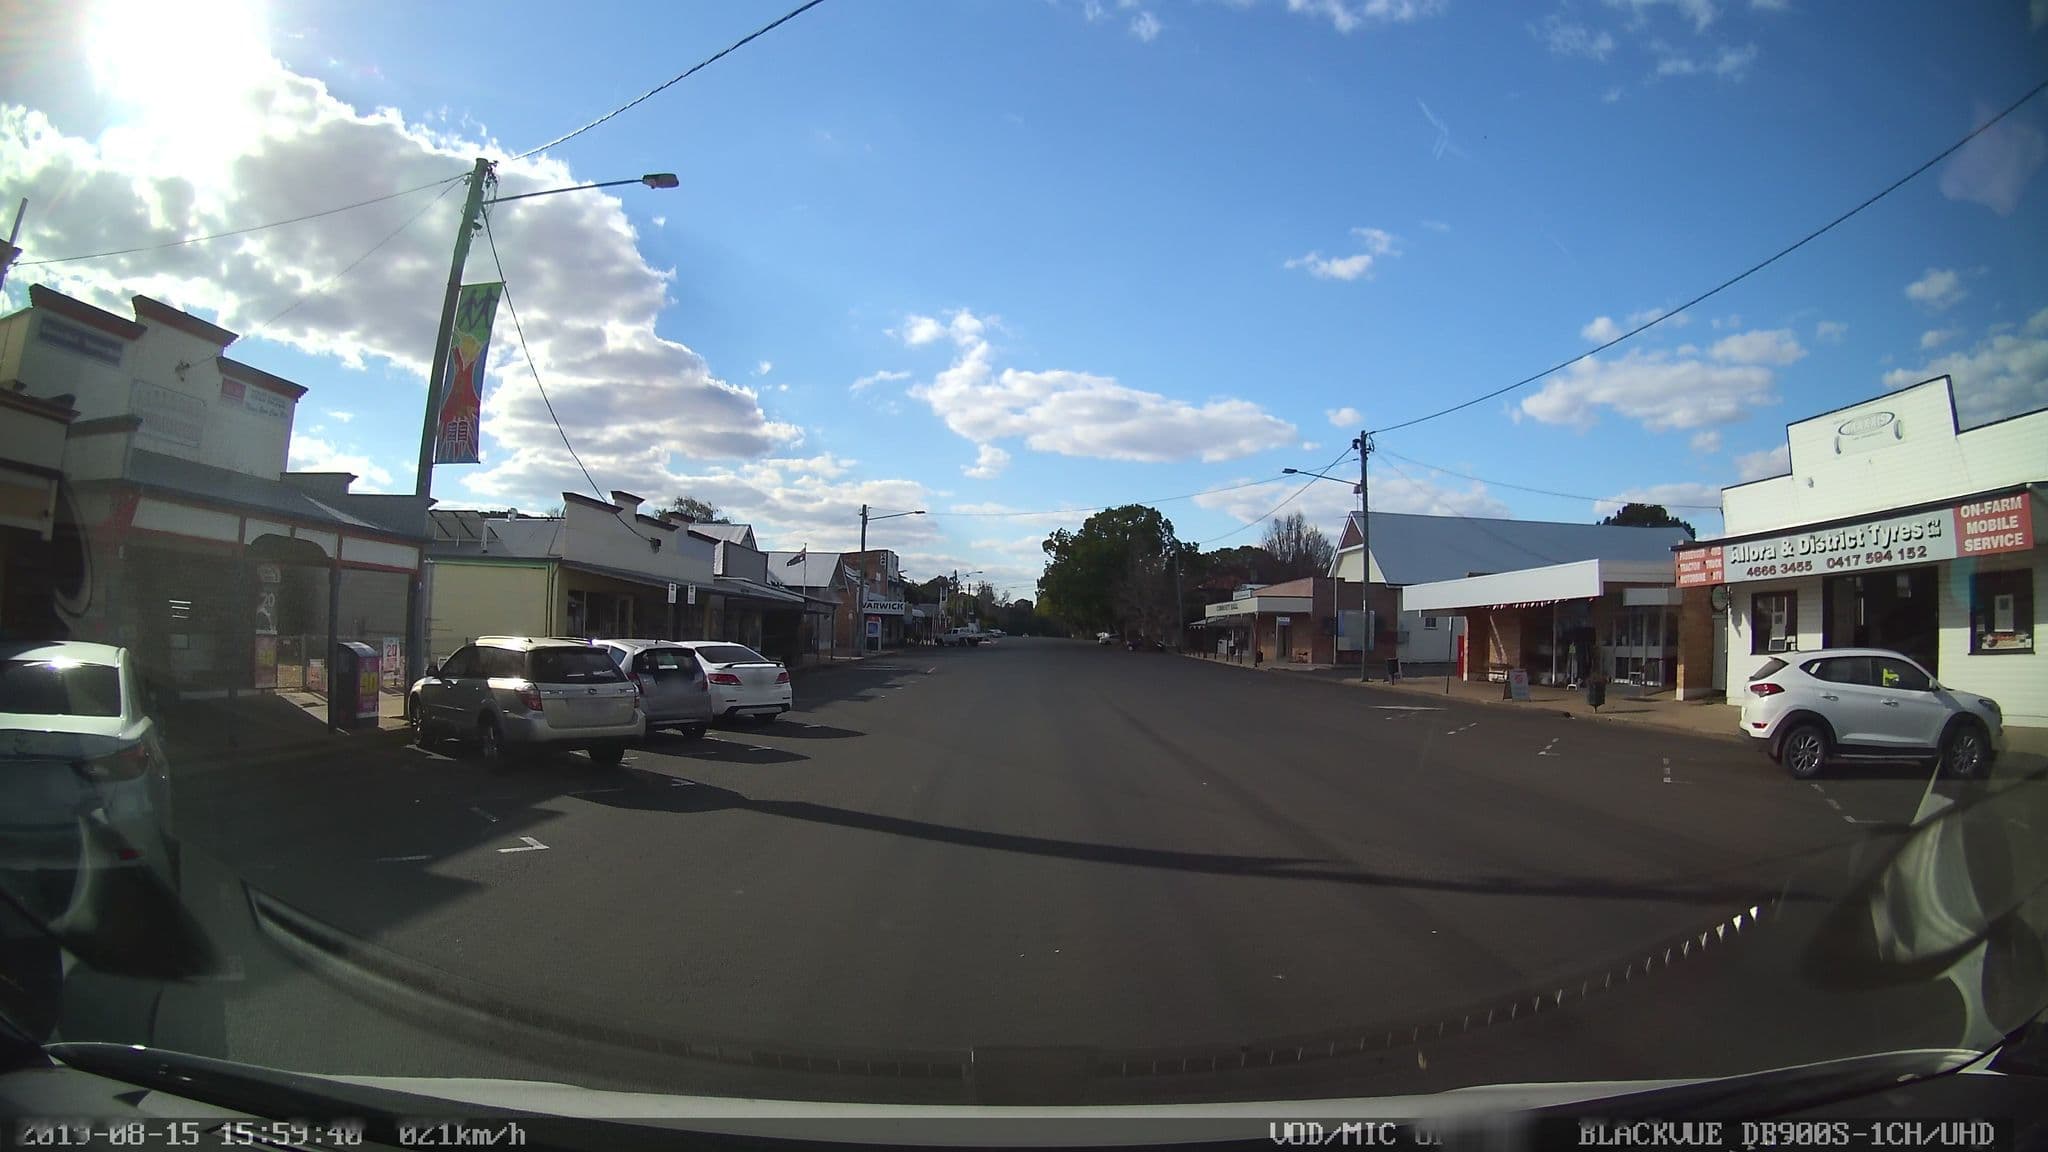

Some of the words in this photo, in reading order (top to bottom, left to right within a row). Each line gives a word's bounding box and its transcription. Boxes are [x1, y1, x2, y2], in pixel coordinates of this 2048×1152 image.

[1960, 496, 2022, 518] ON-FARM
[1966, 515, 2019, 535] MOBILE
[1731, 545, 1776, 564] Allora
[1781, 540, 1795, 557] &
[1800, 527, 1866, 555] District
[1868, 522, 1924, 549] Tyres
[1964, 532, 2024, 552] SERVICE
[1746, 566, 1777, 577] 4666
[1780, 561, 1813, 574] 3455
[1826, 554, 1861, 569] 0417
[1865, 551, 1892, 565] 594
[1898, 545, 1928, 561] 152
